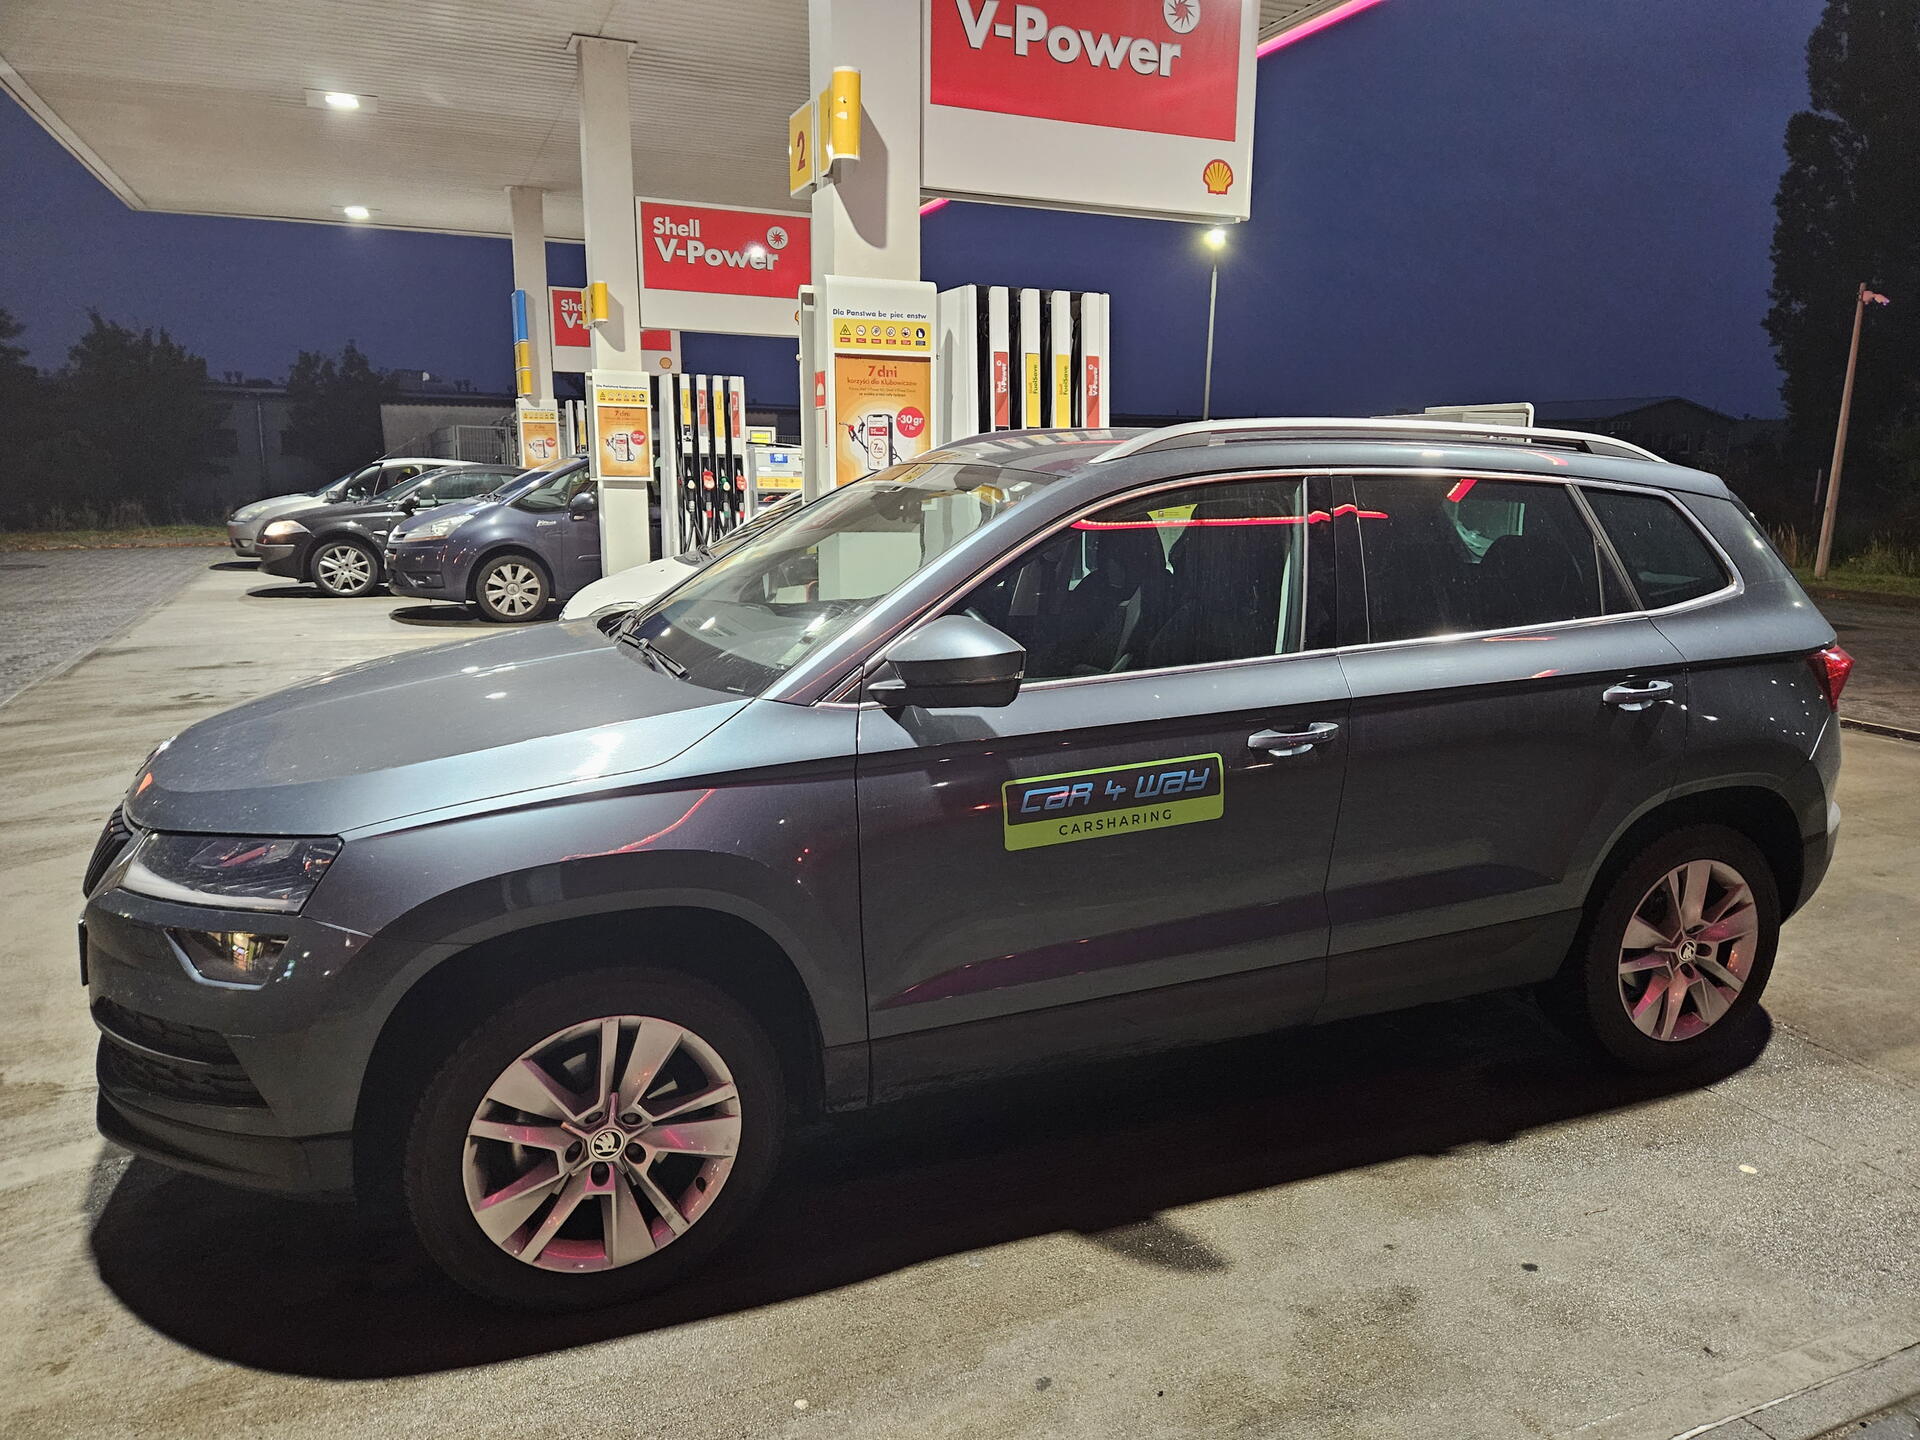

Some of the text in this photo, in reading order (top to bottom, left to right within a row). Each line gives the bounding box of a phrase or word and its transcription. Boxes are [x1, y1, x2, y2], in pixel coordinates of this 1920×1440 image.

[956, 0, 1182, 77] V-Power
[797, 130, 806, 172] 2
[653, 216, 700, 237] Shell
[654, 236, 779, 270] V-Power
[560, 298, 583, 311] She
[868, 365, 897, 378] 7 dni
[897, 415, 924, 426] -30 gr
[1104, 779, 1127, 801] 4
[1058, 809, 1173, 836] CARSHARING
